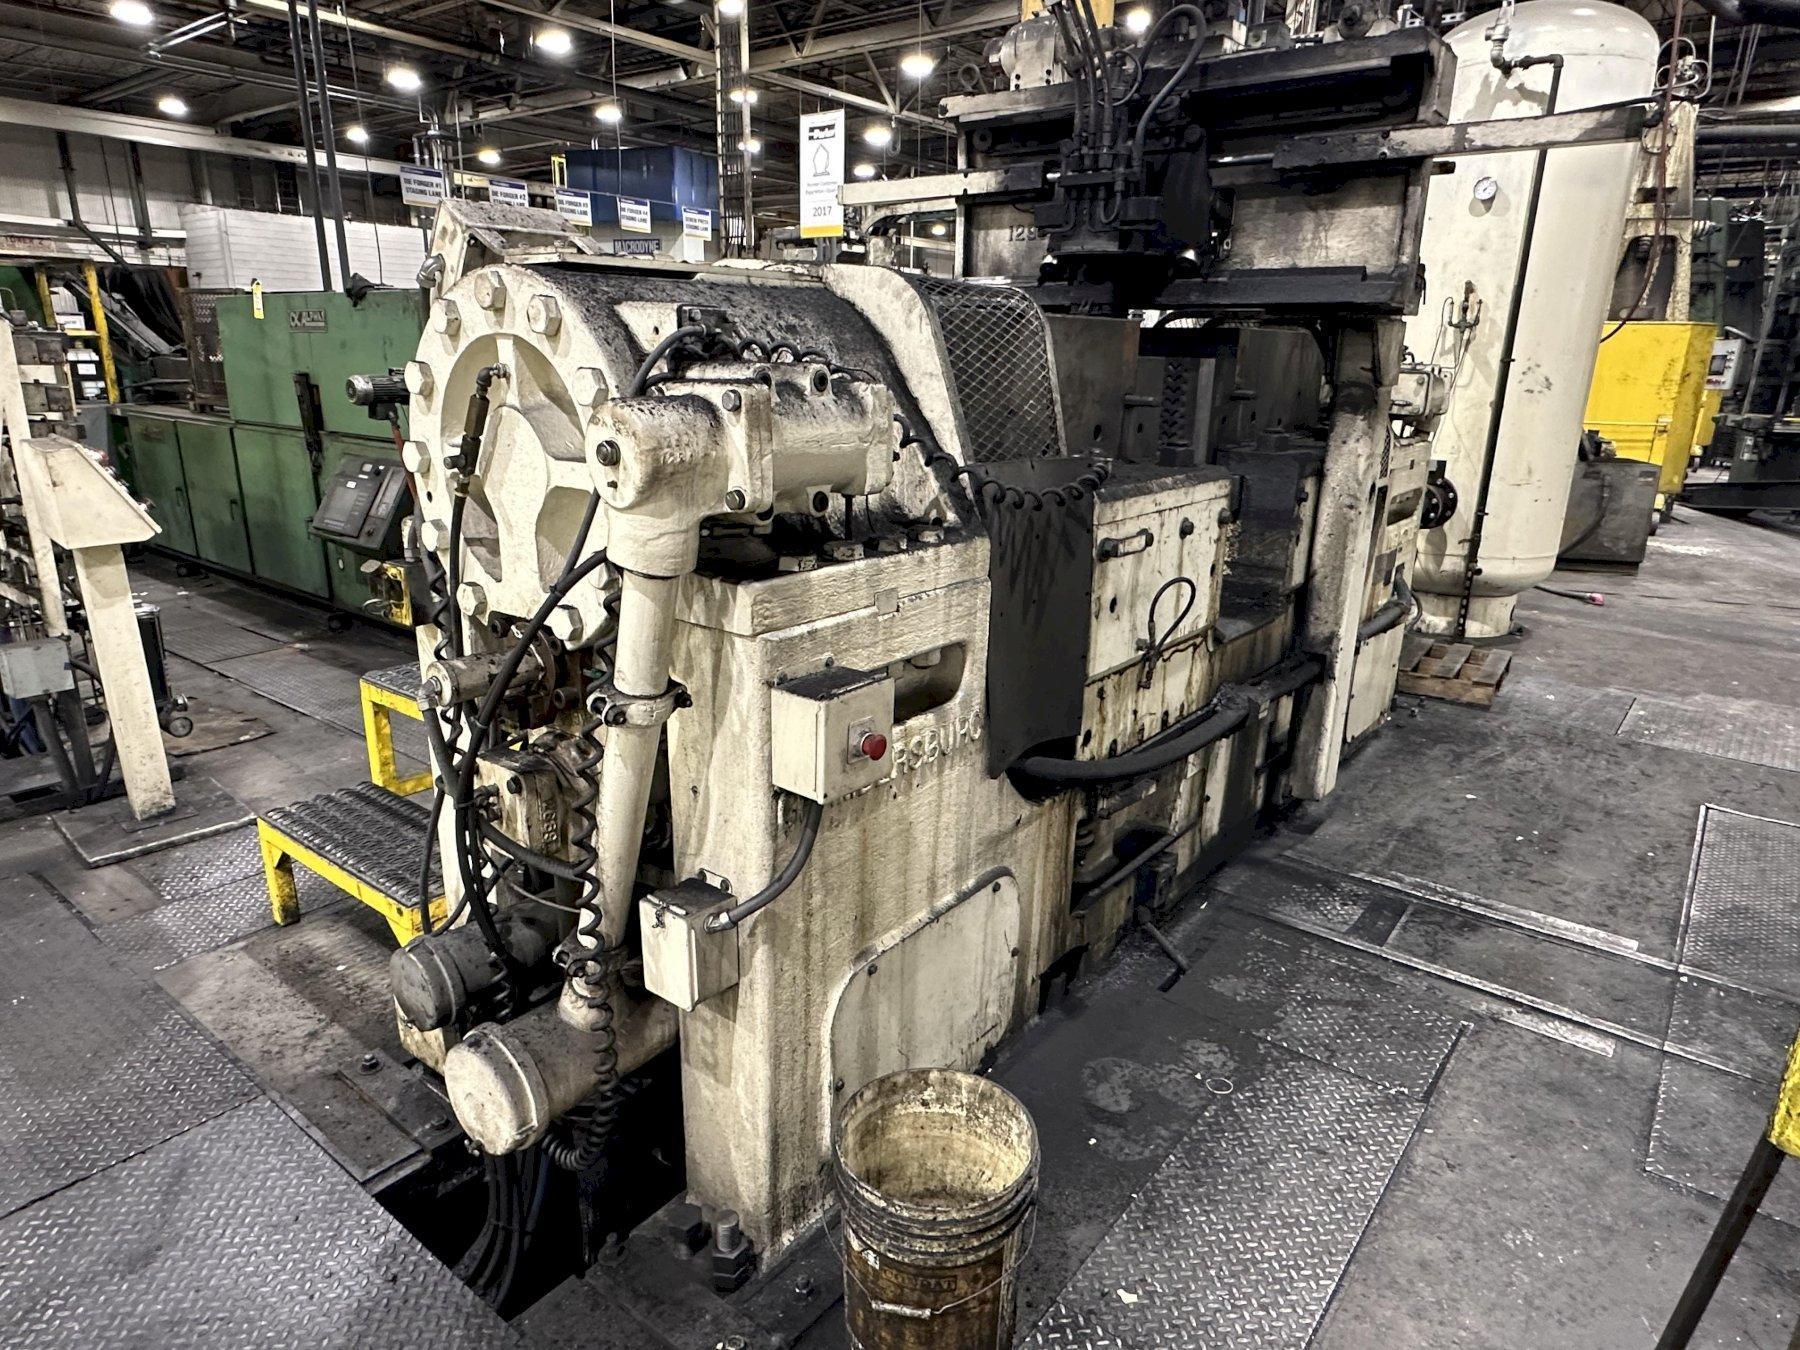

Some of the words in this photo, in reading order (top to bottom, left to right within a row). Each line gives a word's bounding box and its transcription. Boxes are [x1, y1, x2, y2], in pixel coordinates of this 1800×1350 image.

[403, 177, 412, 185] DIE
[413, 179, 434, 188] FORGER
[405, 186, 428, 196] STAGING
[499, 191, 519, 200] FORGER
[565, 200, 582, 208] FORGER
[559, 206, 577, 215] STAGING
[577, 209, 589, 217] LANE
[812, 206, 832, 217] 2017
[637, 217, 648, 225] LANE
[614, 240, 659, 254] MACRODYNE
